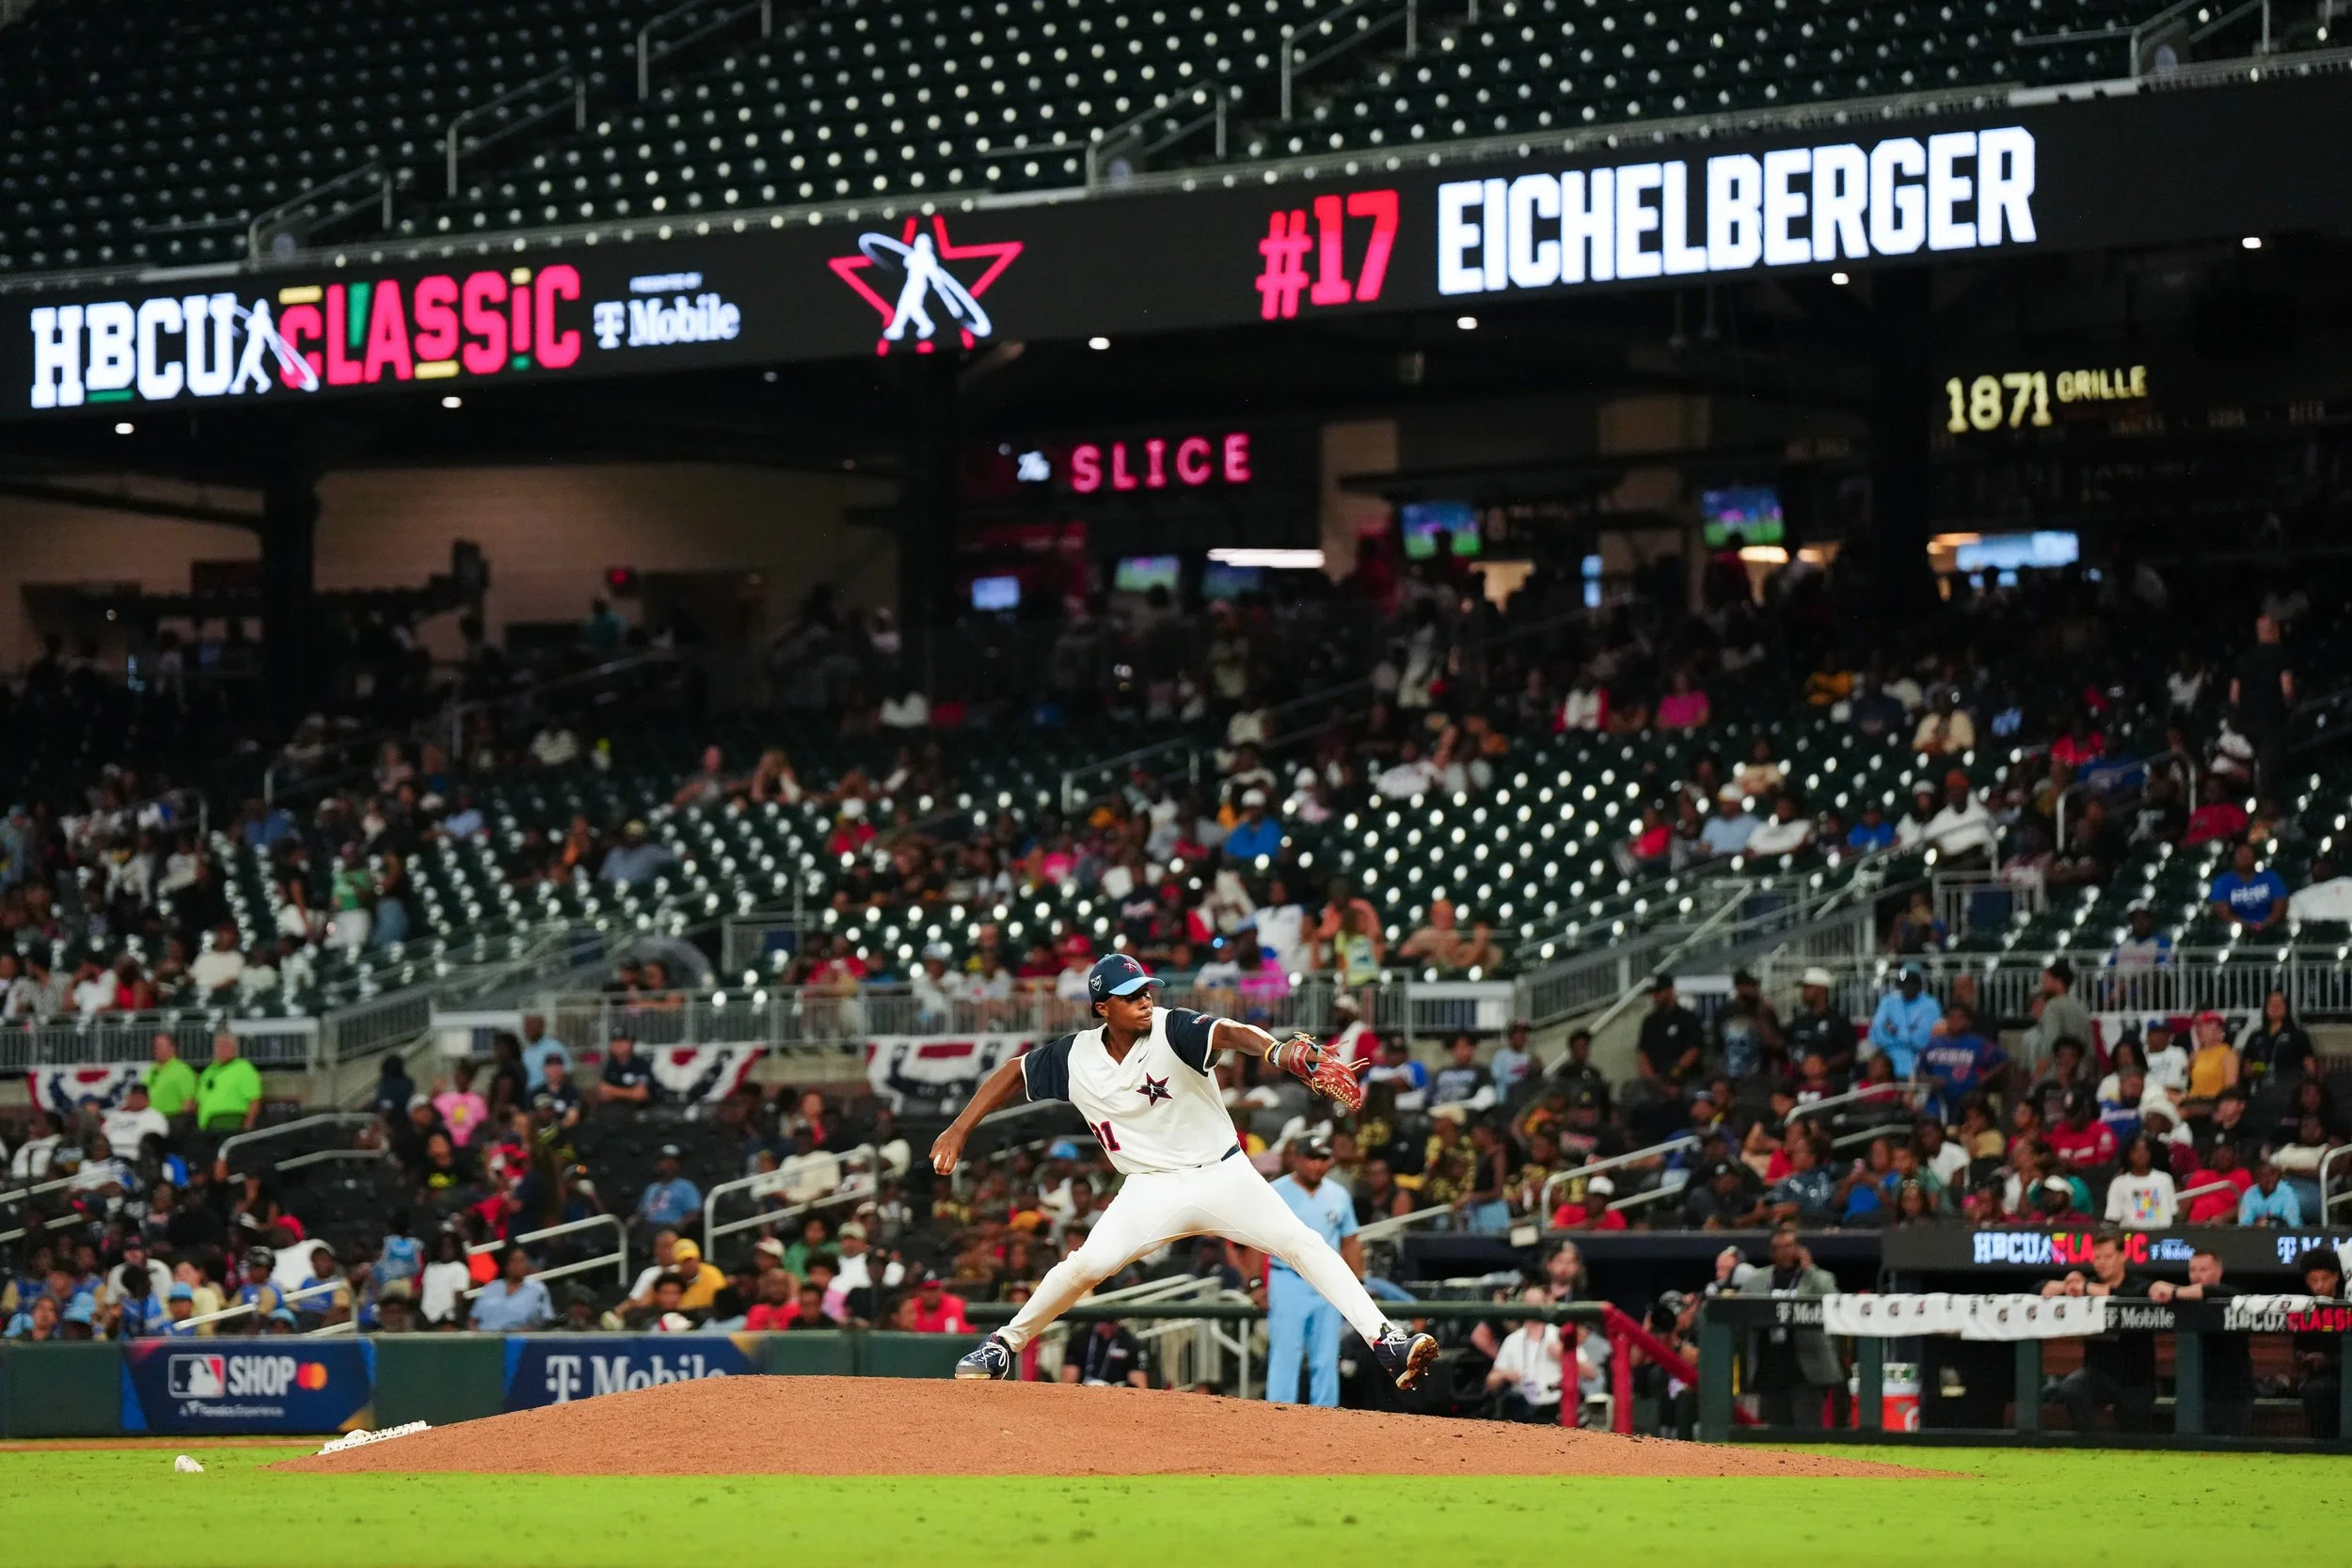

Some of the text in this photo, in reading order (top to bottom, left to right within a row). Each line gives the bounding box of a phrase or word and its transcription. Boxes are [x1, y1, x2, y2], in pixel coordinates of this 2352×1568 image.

[1255, 126, 2037, 320] #17 EICHELBERGER
[31, 264, 580, 409] HBCU CLASSIC
[628, 293, 740, 346] Mobile
[1947, 372, 2052, 433] 1871
[1072, 433, 1252, 493] SLICE
[1973, 1232, 2148, 1264] HBCU CLAIC
[2121, 1307, 2176, 1328] Mobile
[228, 1355, 297, 1397] SHOP
